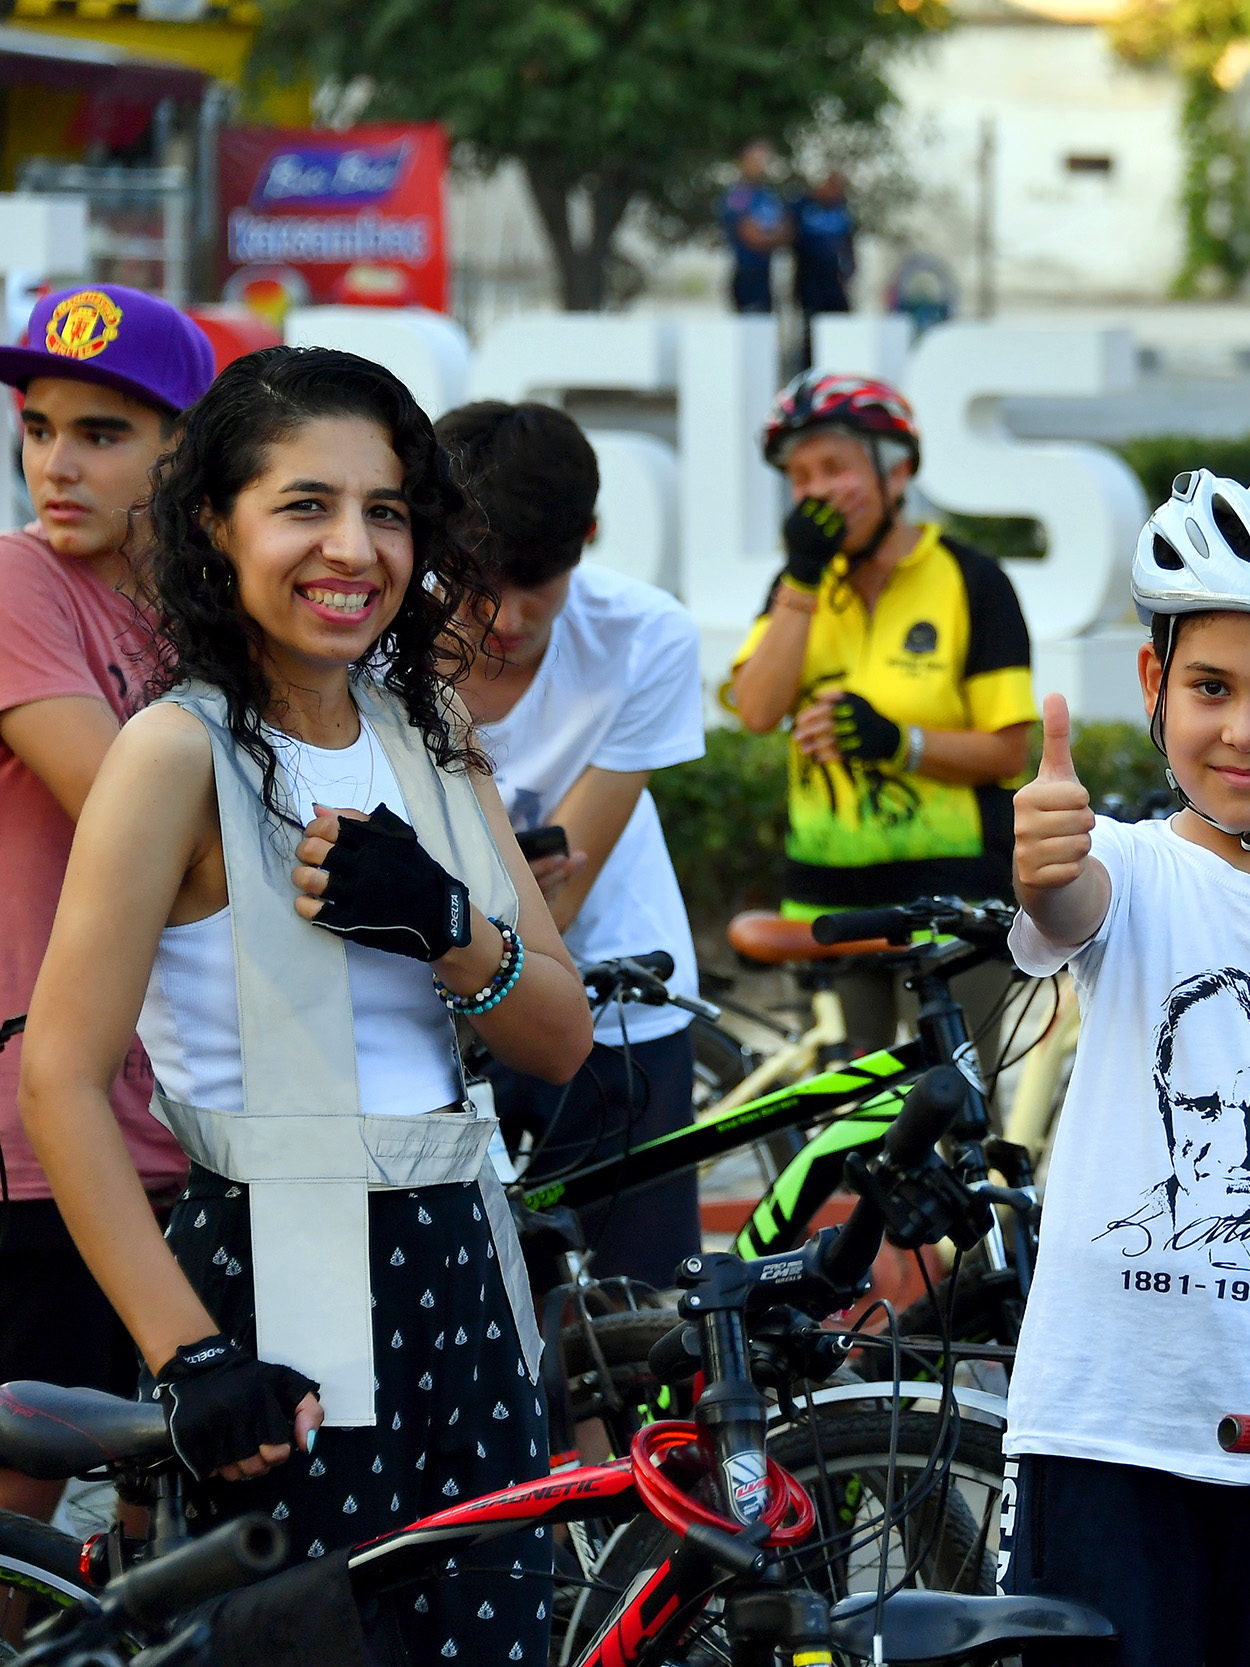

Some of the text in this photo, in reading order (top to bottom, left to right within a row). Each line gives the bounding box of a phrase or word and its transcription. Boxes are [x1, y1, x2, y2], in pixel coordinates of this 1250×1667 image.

[451, 894, 459, 929] DELTA
[183, 1348, 216, 1364] DELTA
[466, 1477, 605, 1511] MAGNETIC
